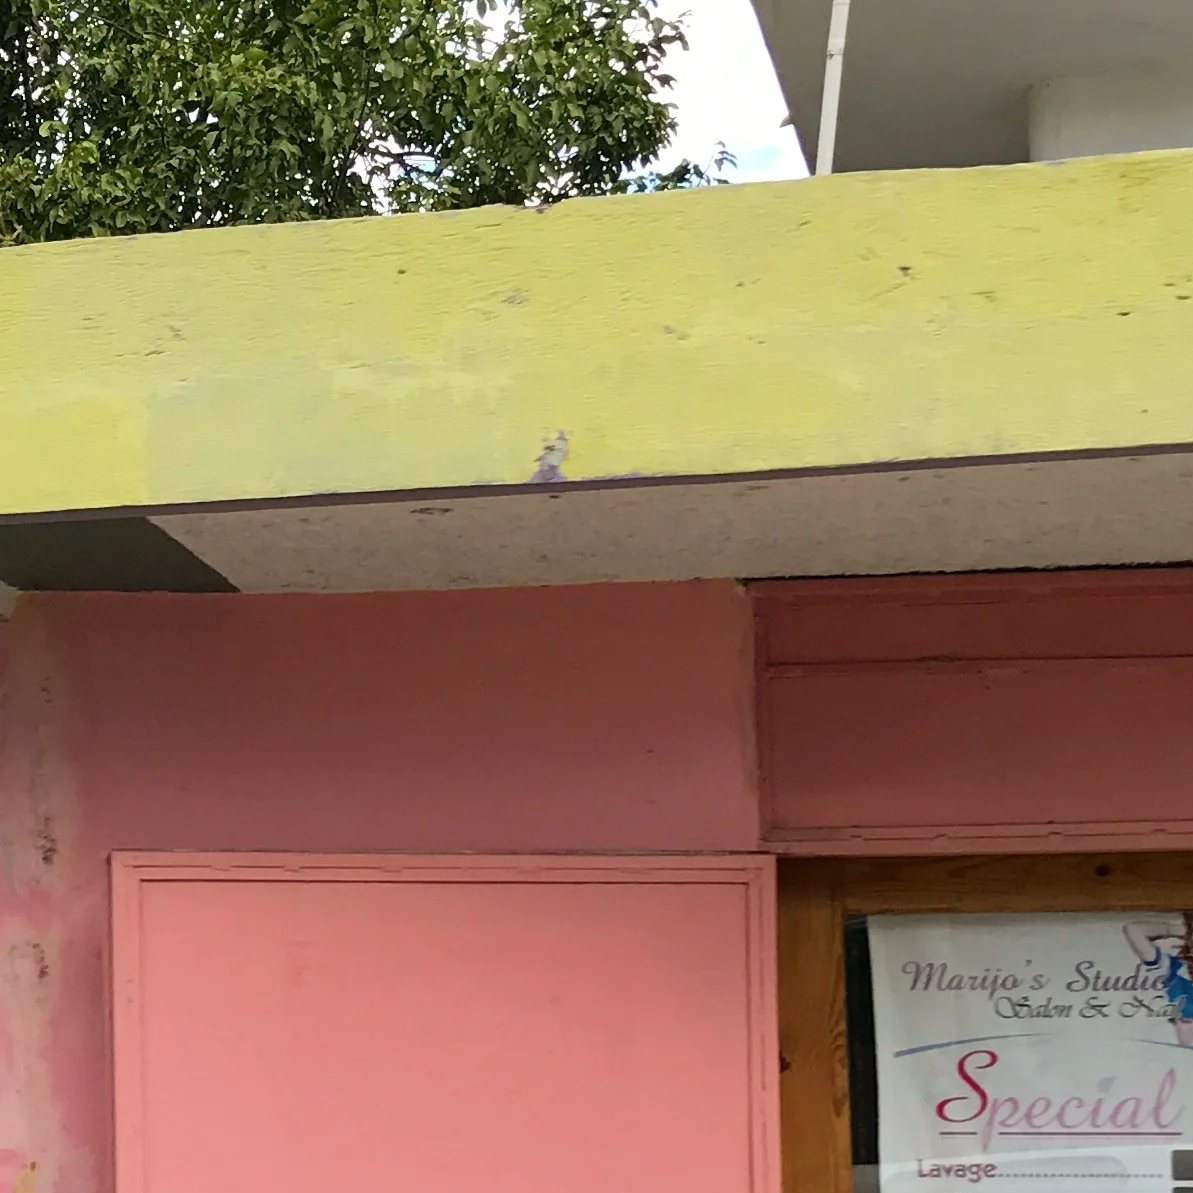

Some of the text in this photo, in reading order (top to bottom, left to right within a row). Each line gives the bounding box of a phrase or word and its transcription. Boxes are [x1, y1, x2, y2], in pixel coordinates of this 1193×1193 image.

[901, 960, 1170, 1001] Marijo's Studio
[994, 996, 1073, 1019] Salon
[1079, 996, 1111, 1019] &
[935, 1050, 1185, 1152] Special
[917, 1159, 997, 1182] Lavage
